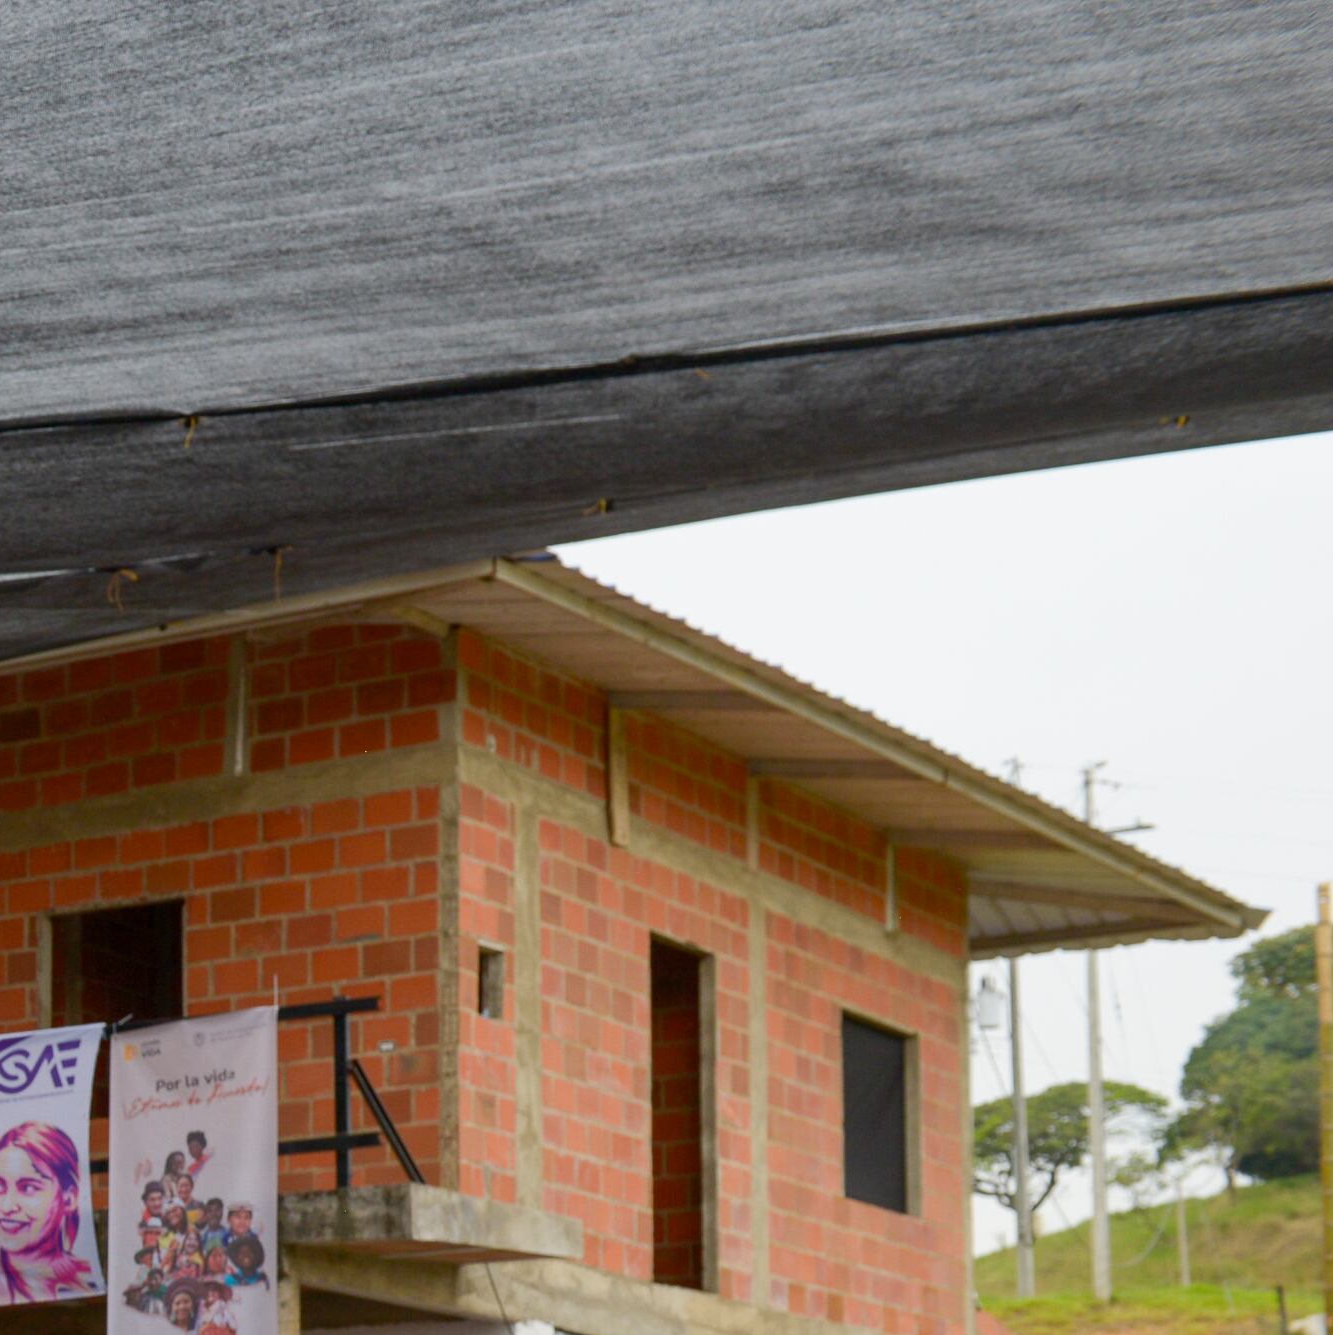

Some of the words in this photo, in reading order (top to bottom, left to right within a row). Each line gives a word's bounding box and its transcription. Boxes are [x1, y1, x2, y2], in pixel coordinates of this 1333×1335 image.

[155, 1078, 181, 1093] Por
[184, 1074, 199, 1089] la
[204, 1067, 236, 1085] vida
